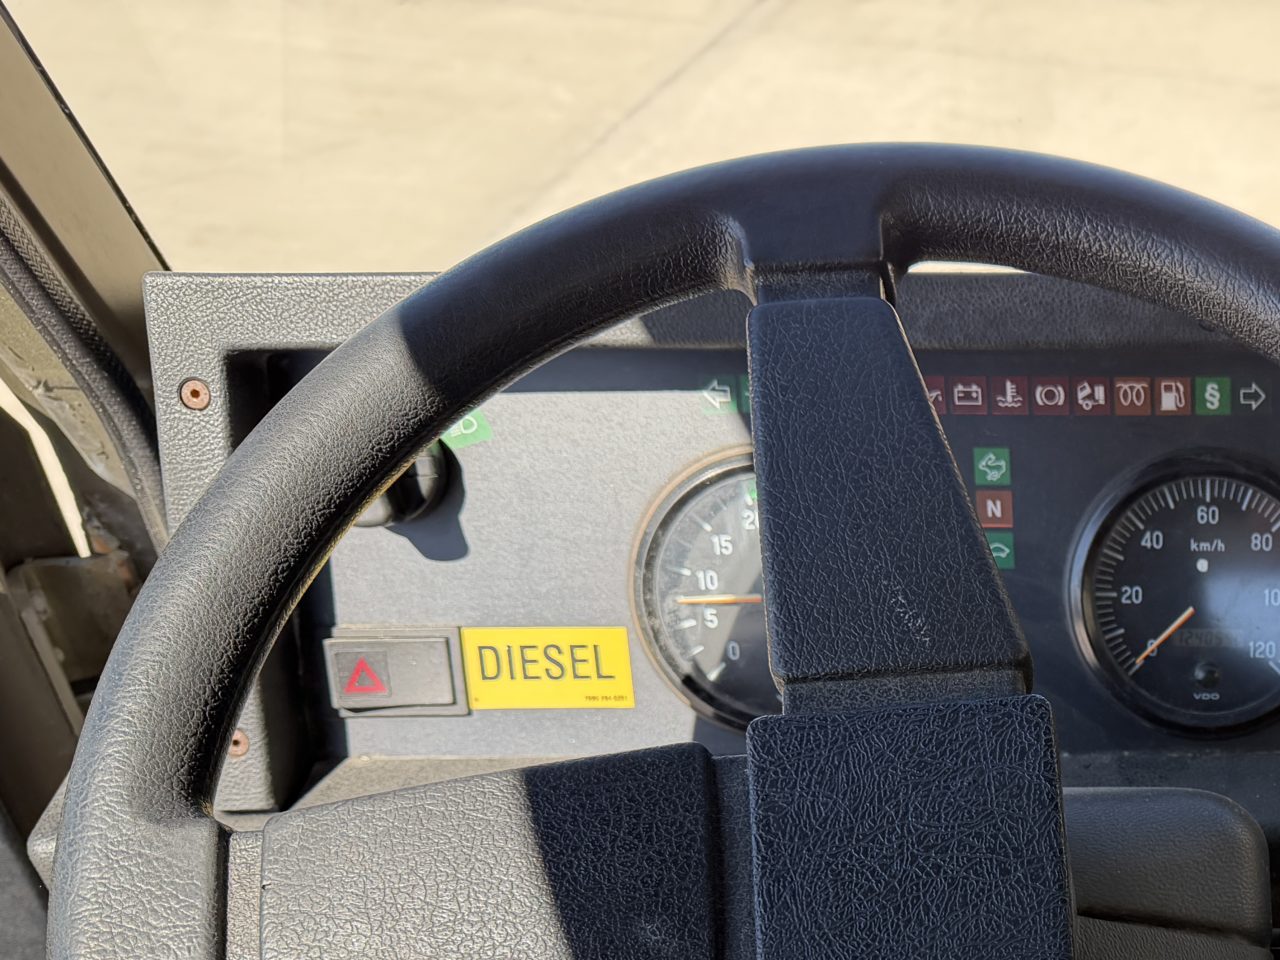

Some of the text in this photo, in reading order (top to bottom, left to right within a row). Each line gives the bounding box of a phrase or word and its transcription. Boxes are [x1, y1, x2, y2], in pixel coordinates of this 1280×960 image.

[986, 499, 1002, 518] N
[1196, 506, 1220, 525] 60
[711, 533, 734, 556] 15
[1140, 530, 1164, 550] 40
[1190, 538, 1226, 552] km/h
[1251, 532, 1273, 552] 80
[695, 569, 719, 591] 10
[1120, 586, 1143, 605] 20
[703, 607, 719, 629] 5
[728, 640, 741, 661] 0
[1249, 641, 1277, 660] 120
[477, 644, 616, 681] DIESEL
[1192, 691, 1221, 701] VDO
